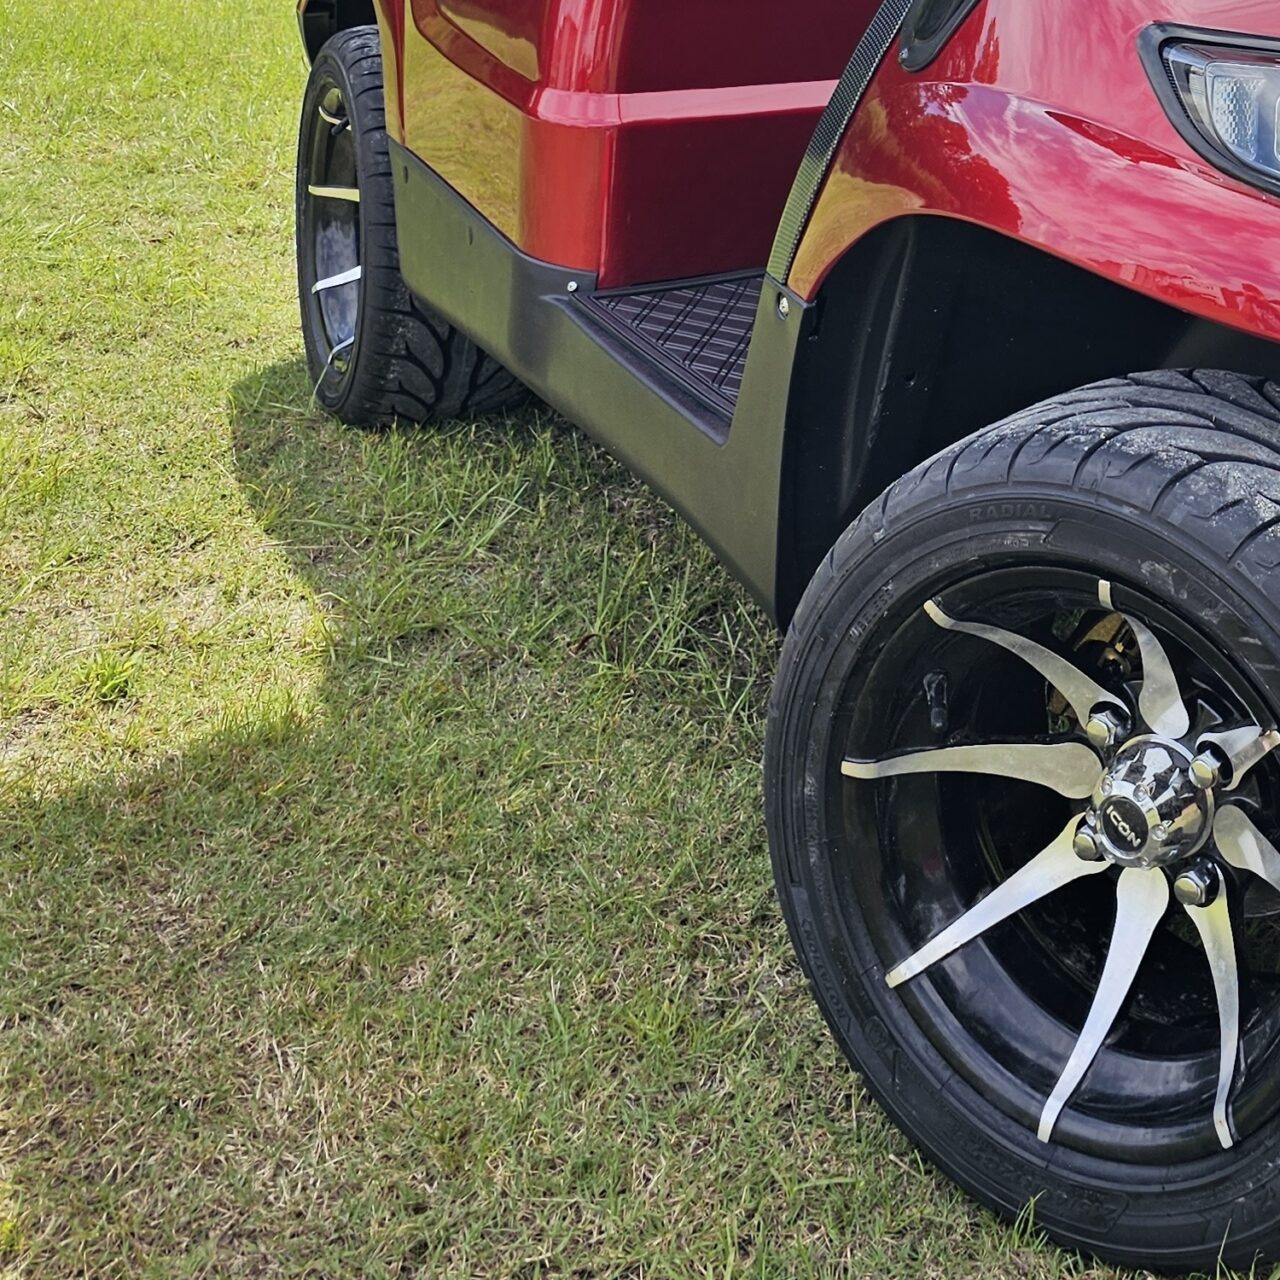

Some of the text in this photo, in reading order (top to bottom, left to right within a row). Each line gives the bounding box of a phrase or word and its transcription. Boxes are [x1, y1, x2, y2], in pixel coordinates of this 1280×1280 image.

[968, 504, 1051, 522] RADIAL
[1106, 805, 1141, 847] ICON
[803, 928, 848, 1019] ROTATION
